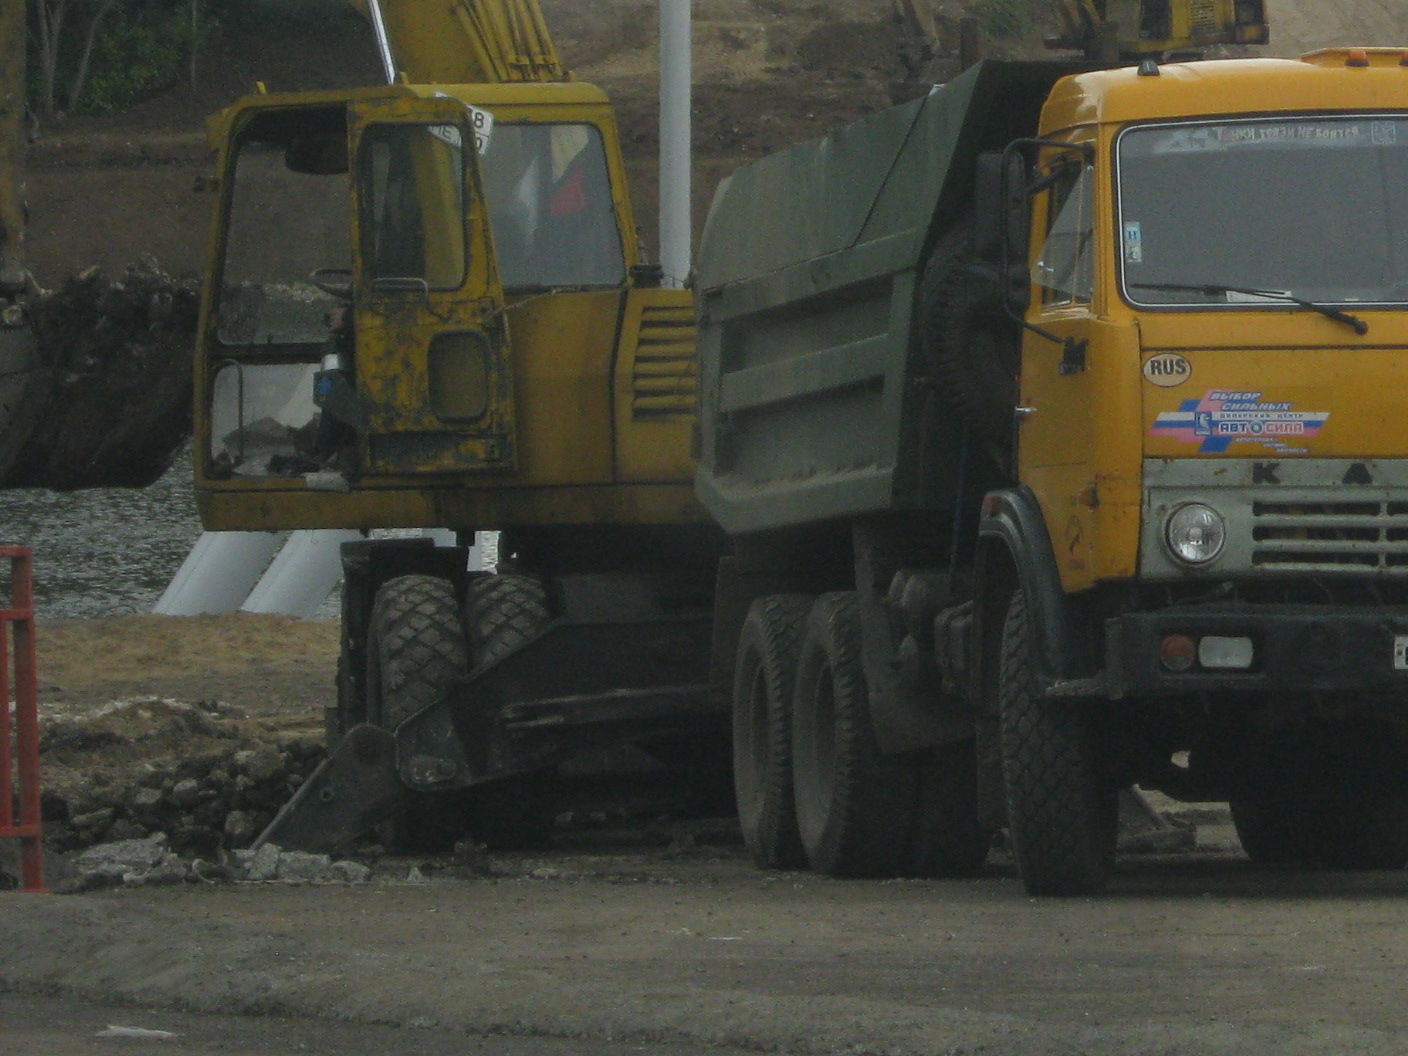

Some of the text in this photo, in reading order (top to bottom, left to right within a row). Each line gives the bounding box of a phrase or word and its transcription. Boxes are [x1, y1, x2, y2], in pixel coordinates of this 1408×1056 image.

[1149, 357, 1187, 376] RUS
[1209, 391, 1261, 401] ВЫБОР
[1220, 402, 1291, 412] СИЛЬНЫХ
